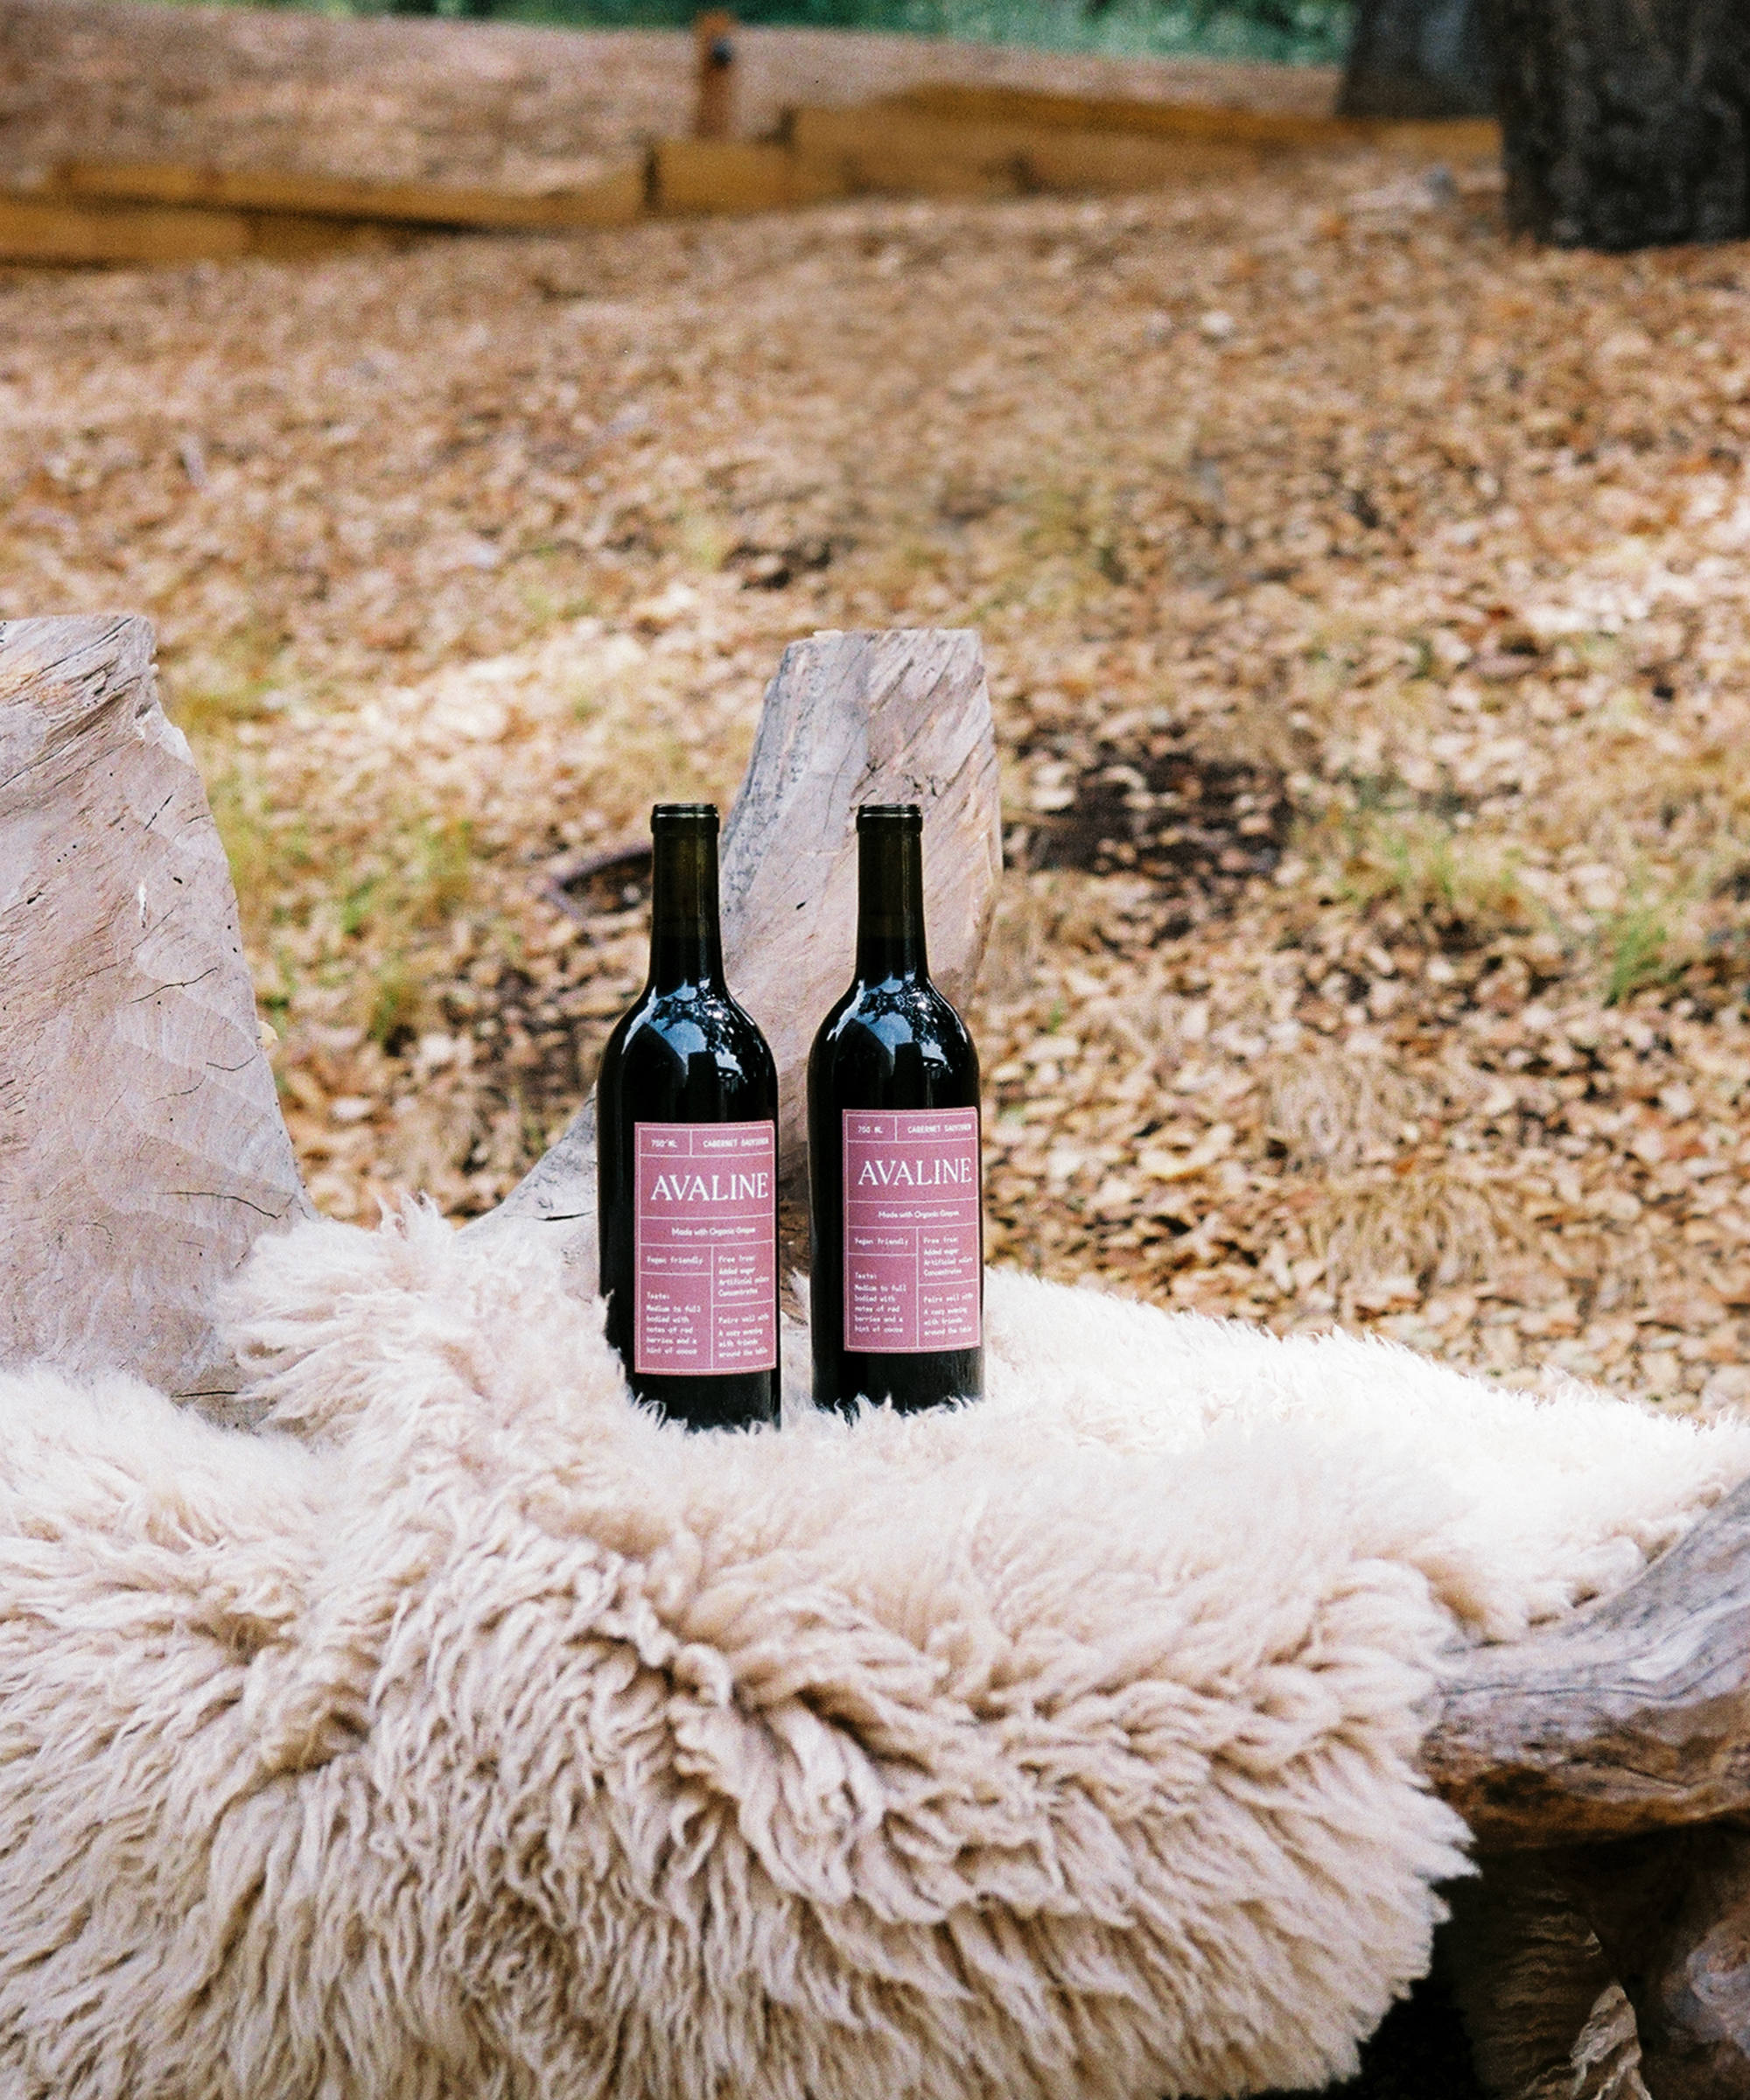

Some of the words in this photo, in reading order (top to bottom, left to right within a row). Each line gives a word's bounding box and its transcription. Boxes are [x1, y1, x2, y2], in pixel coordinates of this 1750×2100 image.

[858, 1158, 972, 1186] AVALINE
[651, 1172, 769, 1201] AVALINE
[914, 1210, 938, 1219] Organic
[710, 1227, 734, 1236] Organic
[855, 1237, 873, 1246] Vegan
[670, 1256, 703, 1264] friendly
